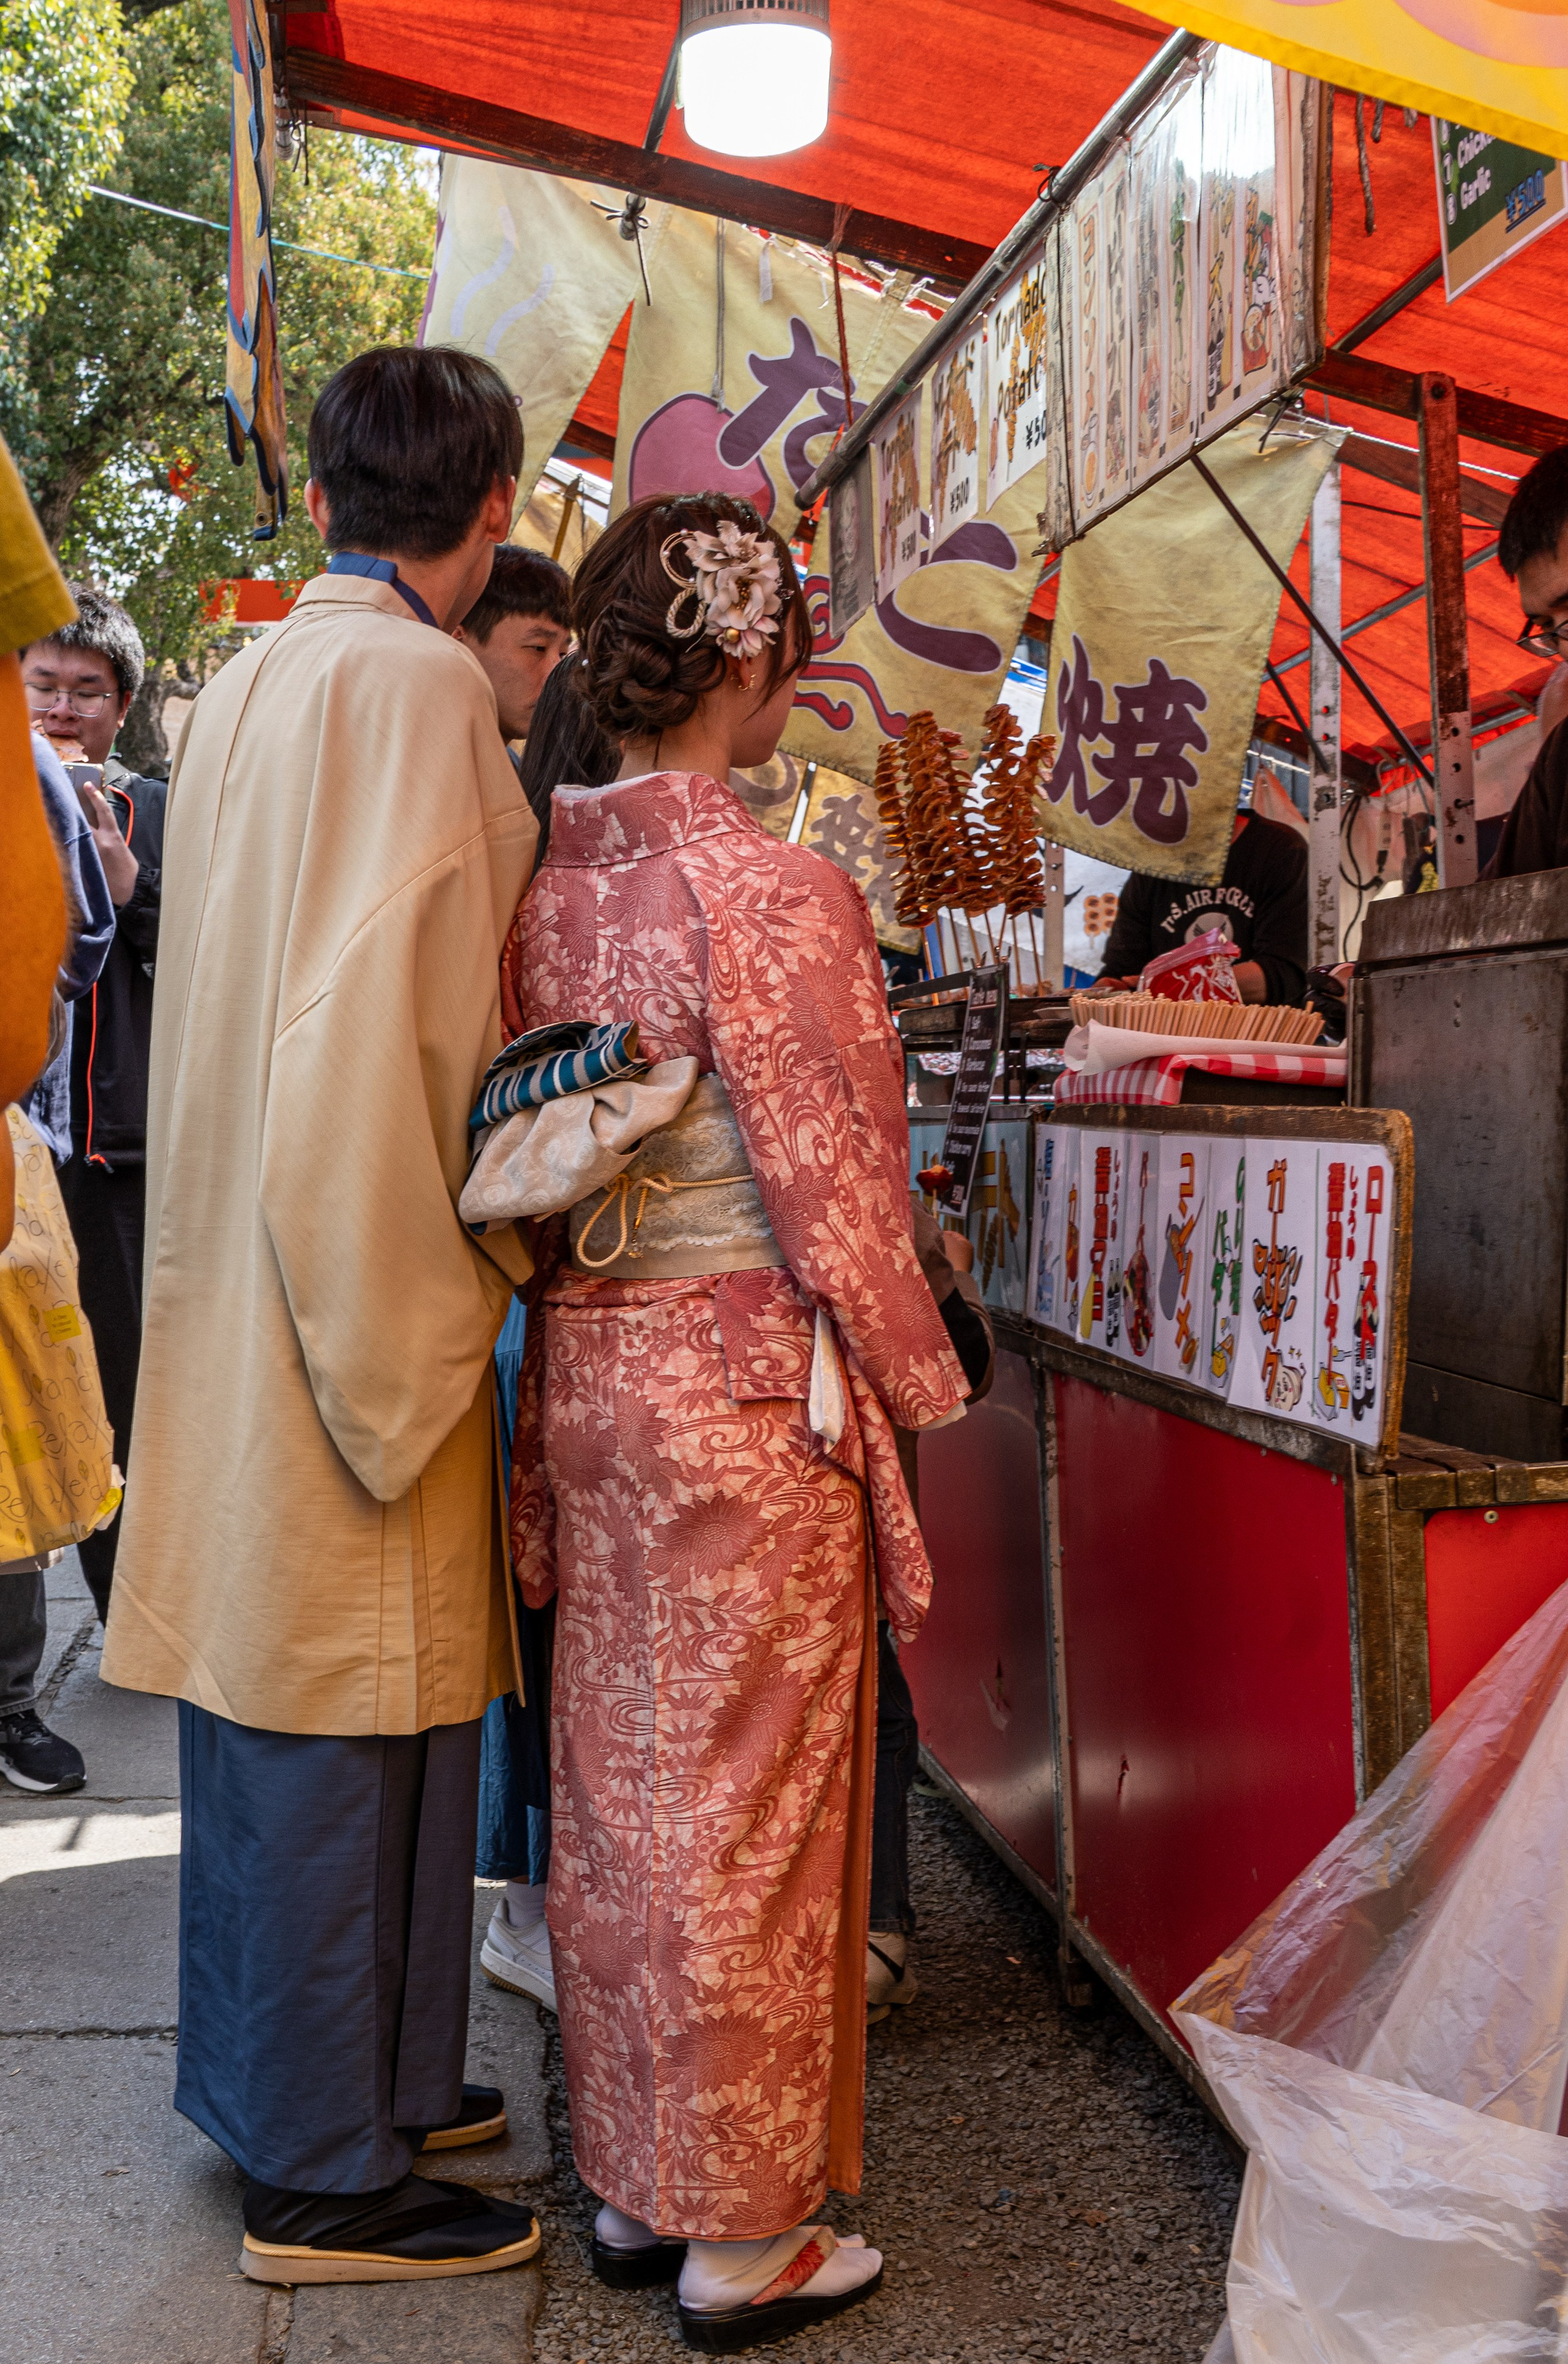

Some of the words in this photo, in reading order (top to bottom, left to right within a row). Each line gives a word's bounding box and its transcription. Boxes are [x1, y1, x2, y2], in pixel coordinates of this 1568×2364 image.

[1506, 168, 1544, 222] ¥500
[1083, 214, 1097, 428] コンソメ
[1185, 889, 1213, 912] AIR
[1175, 1152, 1195, 1350] コンソメ
[1262, 1158, 1287, 1402] ガーリック
[1346, 1165, 1359, 1261] しょうゆ
[1360, 1165, 1384, 1361] ロースト
